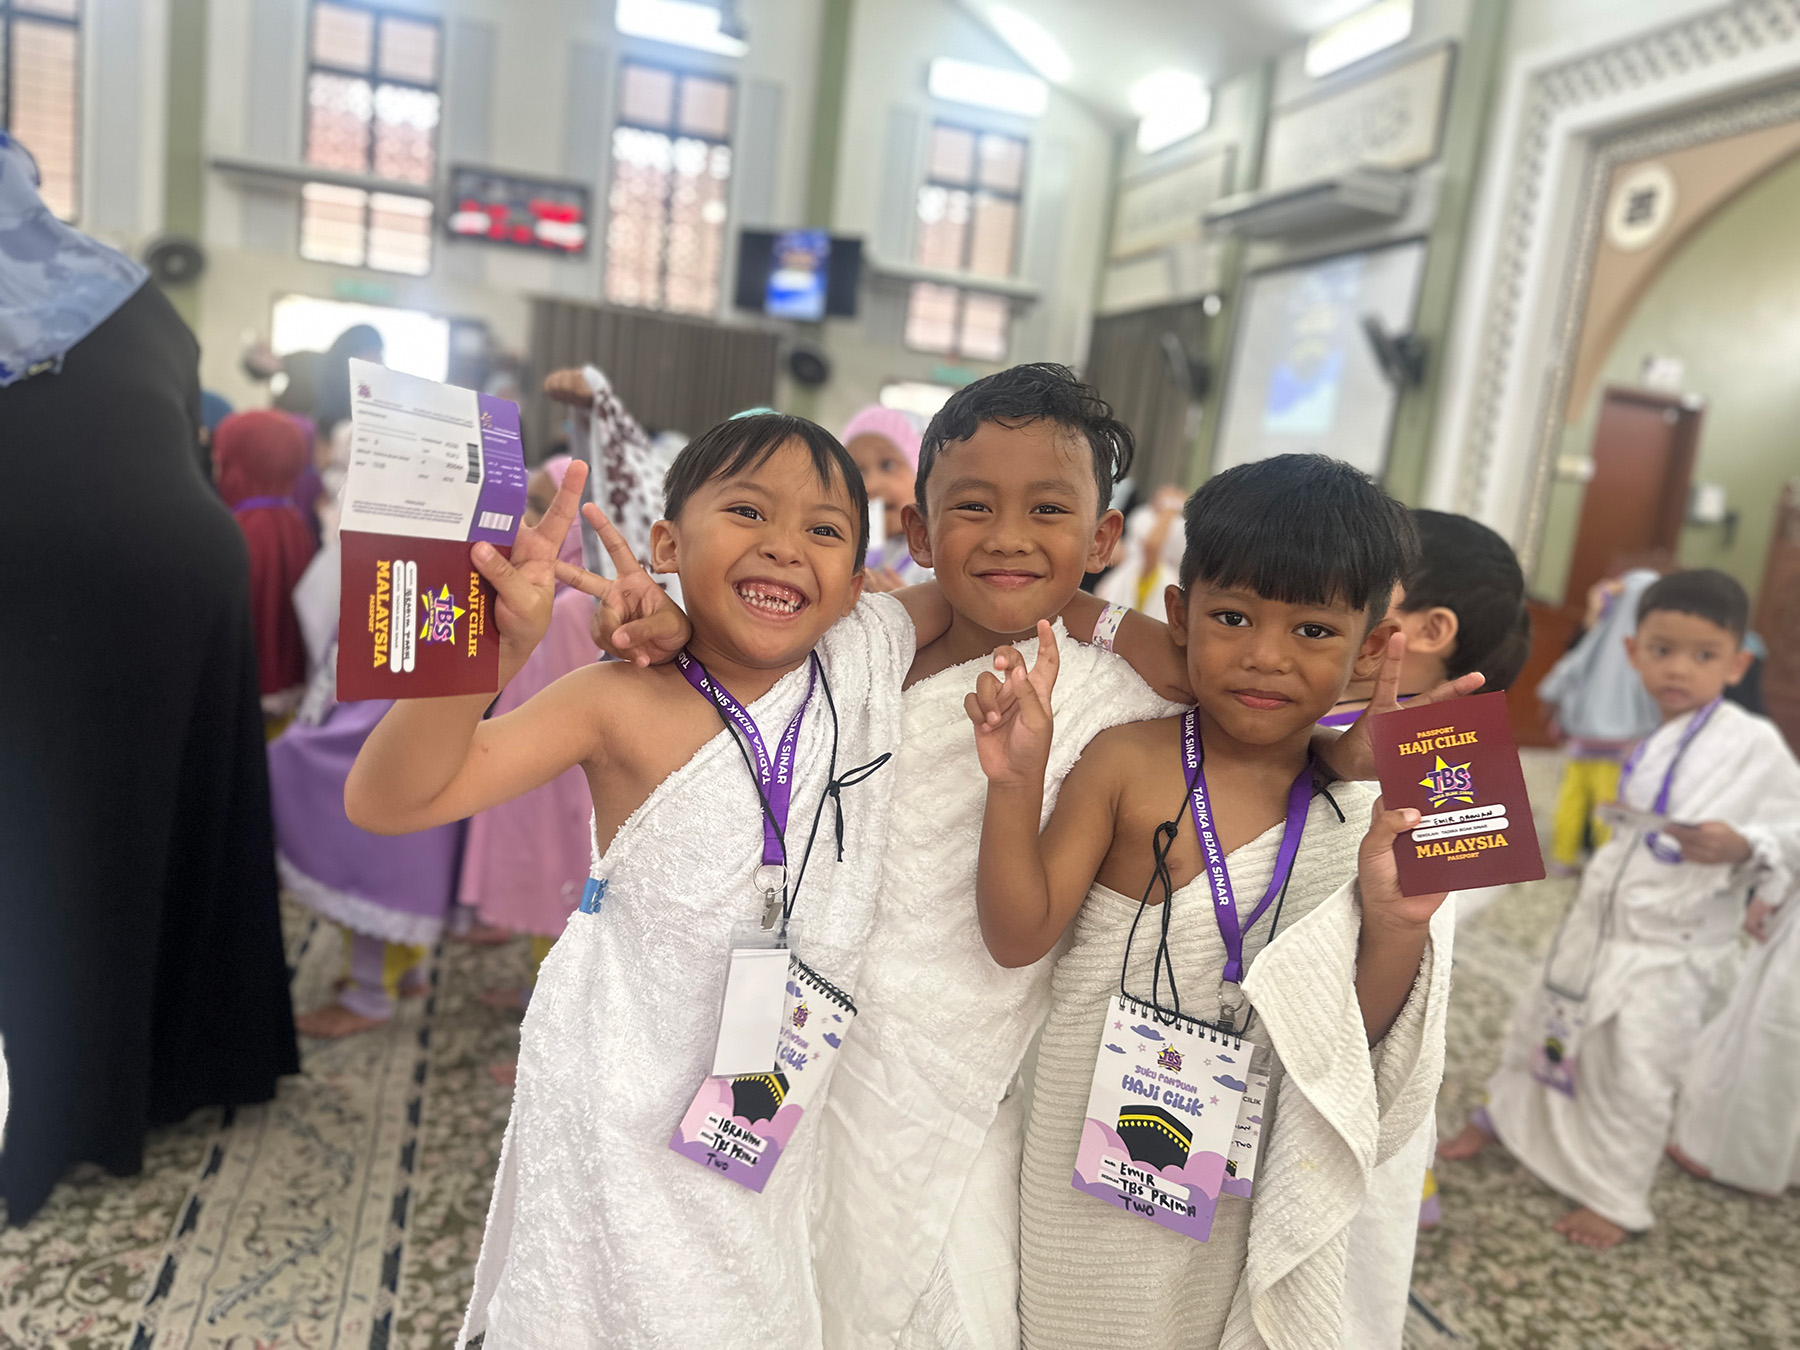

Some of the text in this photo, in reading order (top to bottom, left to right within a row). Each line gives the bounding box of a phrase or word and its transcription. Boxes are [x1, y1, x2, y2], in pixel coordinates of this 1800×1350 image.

[368, 594, 376, 633] PASSPORT
[374, 560, 390, 668] MALAYSIA
[433, 593, 454, 641] TBS
[467, 571, 480, 657] HAJI CILIK
[727, 704, 755, 734] BIJAK
[1416, 726, 1454, 738] PASSPORT
[1185, 737, 1198, 768] SINAR
[1398, 731, 1478, 755] HAJI CILIK
[753, 735, 771, 785] TADIKA
[777, 745, 792, 785] SINAR
[1427, 767, 1470, 792] TBS
[1433, 815, 1455, 827] EMIR
[1193, 787, 1229, 906] TADIKA BIJAK SINAR
[1415, 834, 1508, 858] MALAYSIA
[1447, 852, 1479, 861] PASSPORT
[1160, 1048, 1181, 1066] TBS
[1242, 1095, 1261, 1105] CILIK
[1119, 1162, 1155, 1187] EMIR
[1117, 1194, 1155, 1217] TWO
[1118, 1177, 1196, 1217] TBS PRIMA
